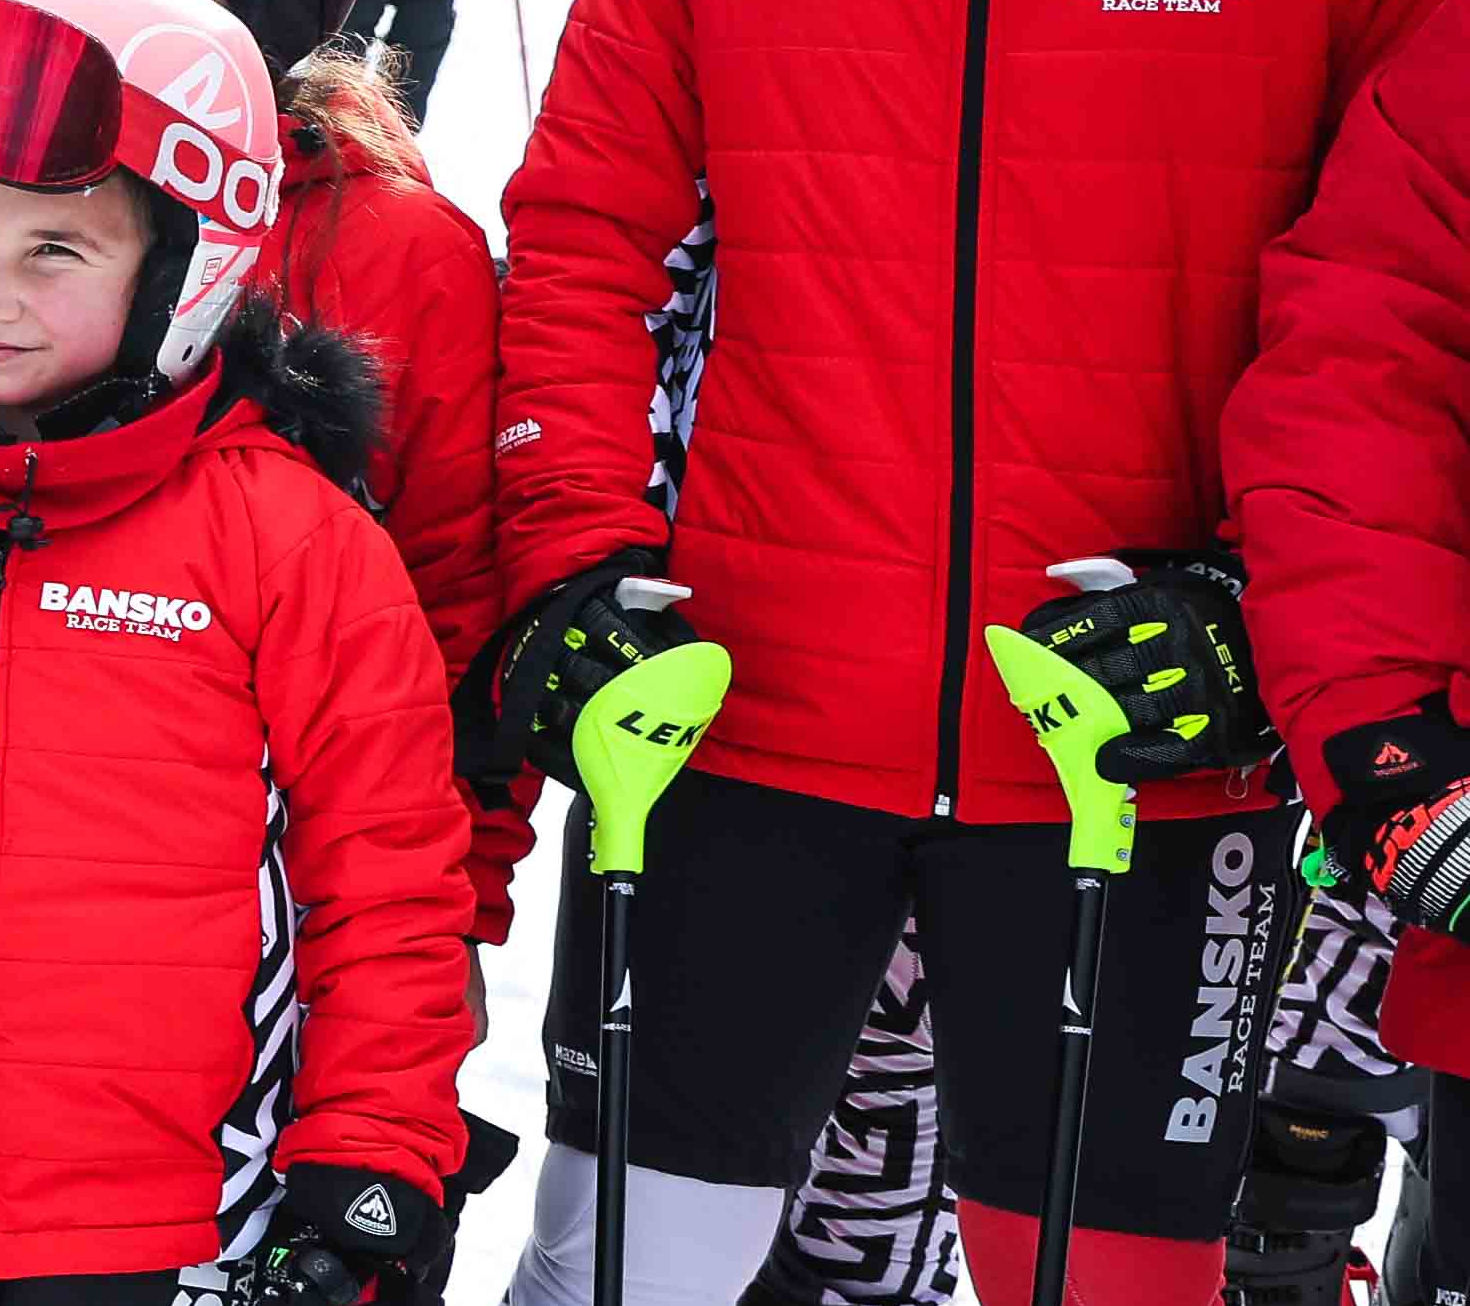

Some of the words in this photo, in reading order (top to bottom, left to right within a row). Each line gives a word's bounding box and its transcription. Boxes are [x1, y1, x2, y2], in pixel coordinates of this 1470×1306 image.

[40, 582, 211, 632] BANSKO
[65, 613, 120, 634] RACE
[123, 619, 182, 643] TEAM
[1205, 623, 1244, 694] LEKI
[1164, 831, 1254, 1144] BANSKO
[1227, 994, 1258, 1095] RACE
[1243, 880, 1276, 989] TEAM
